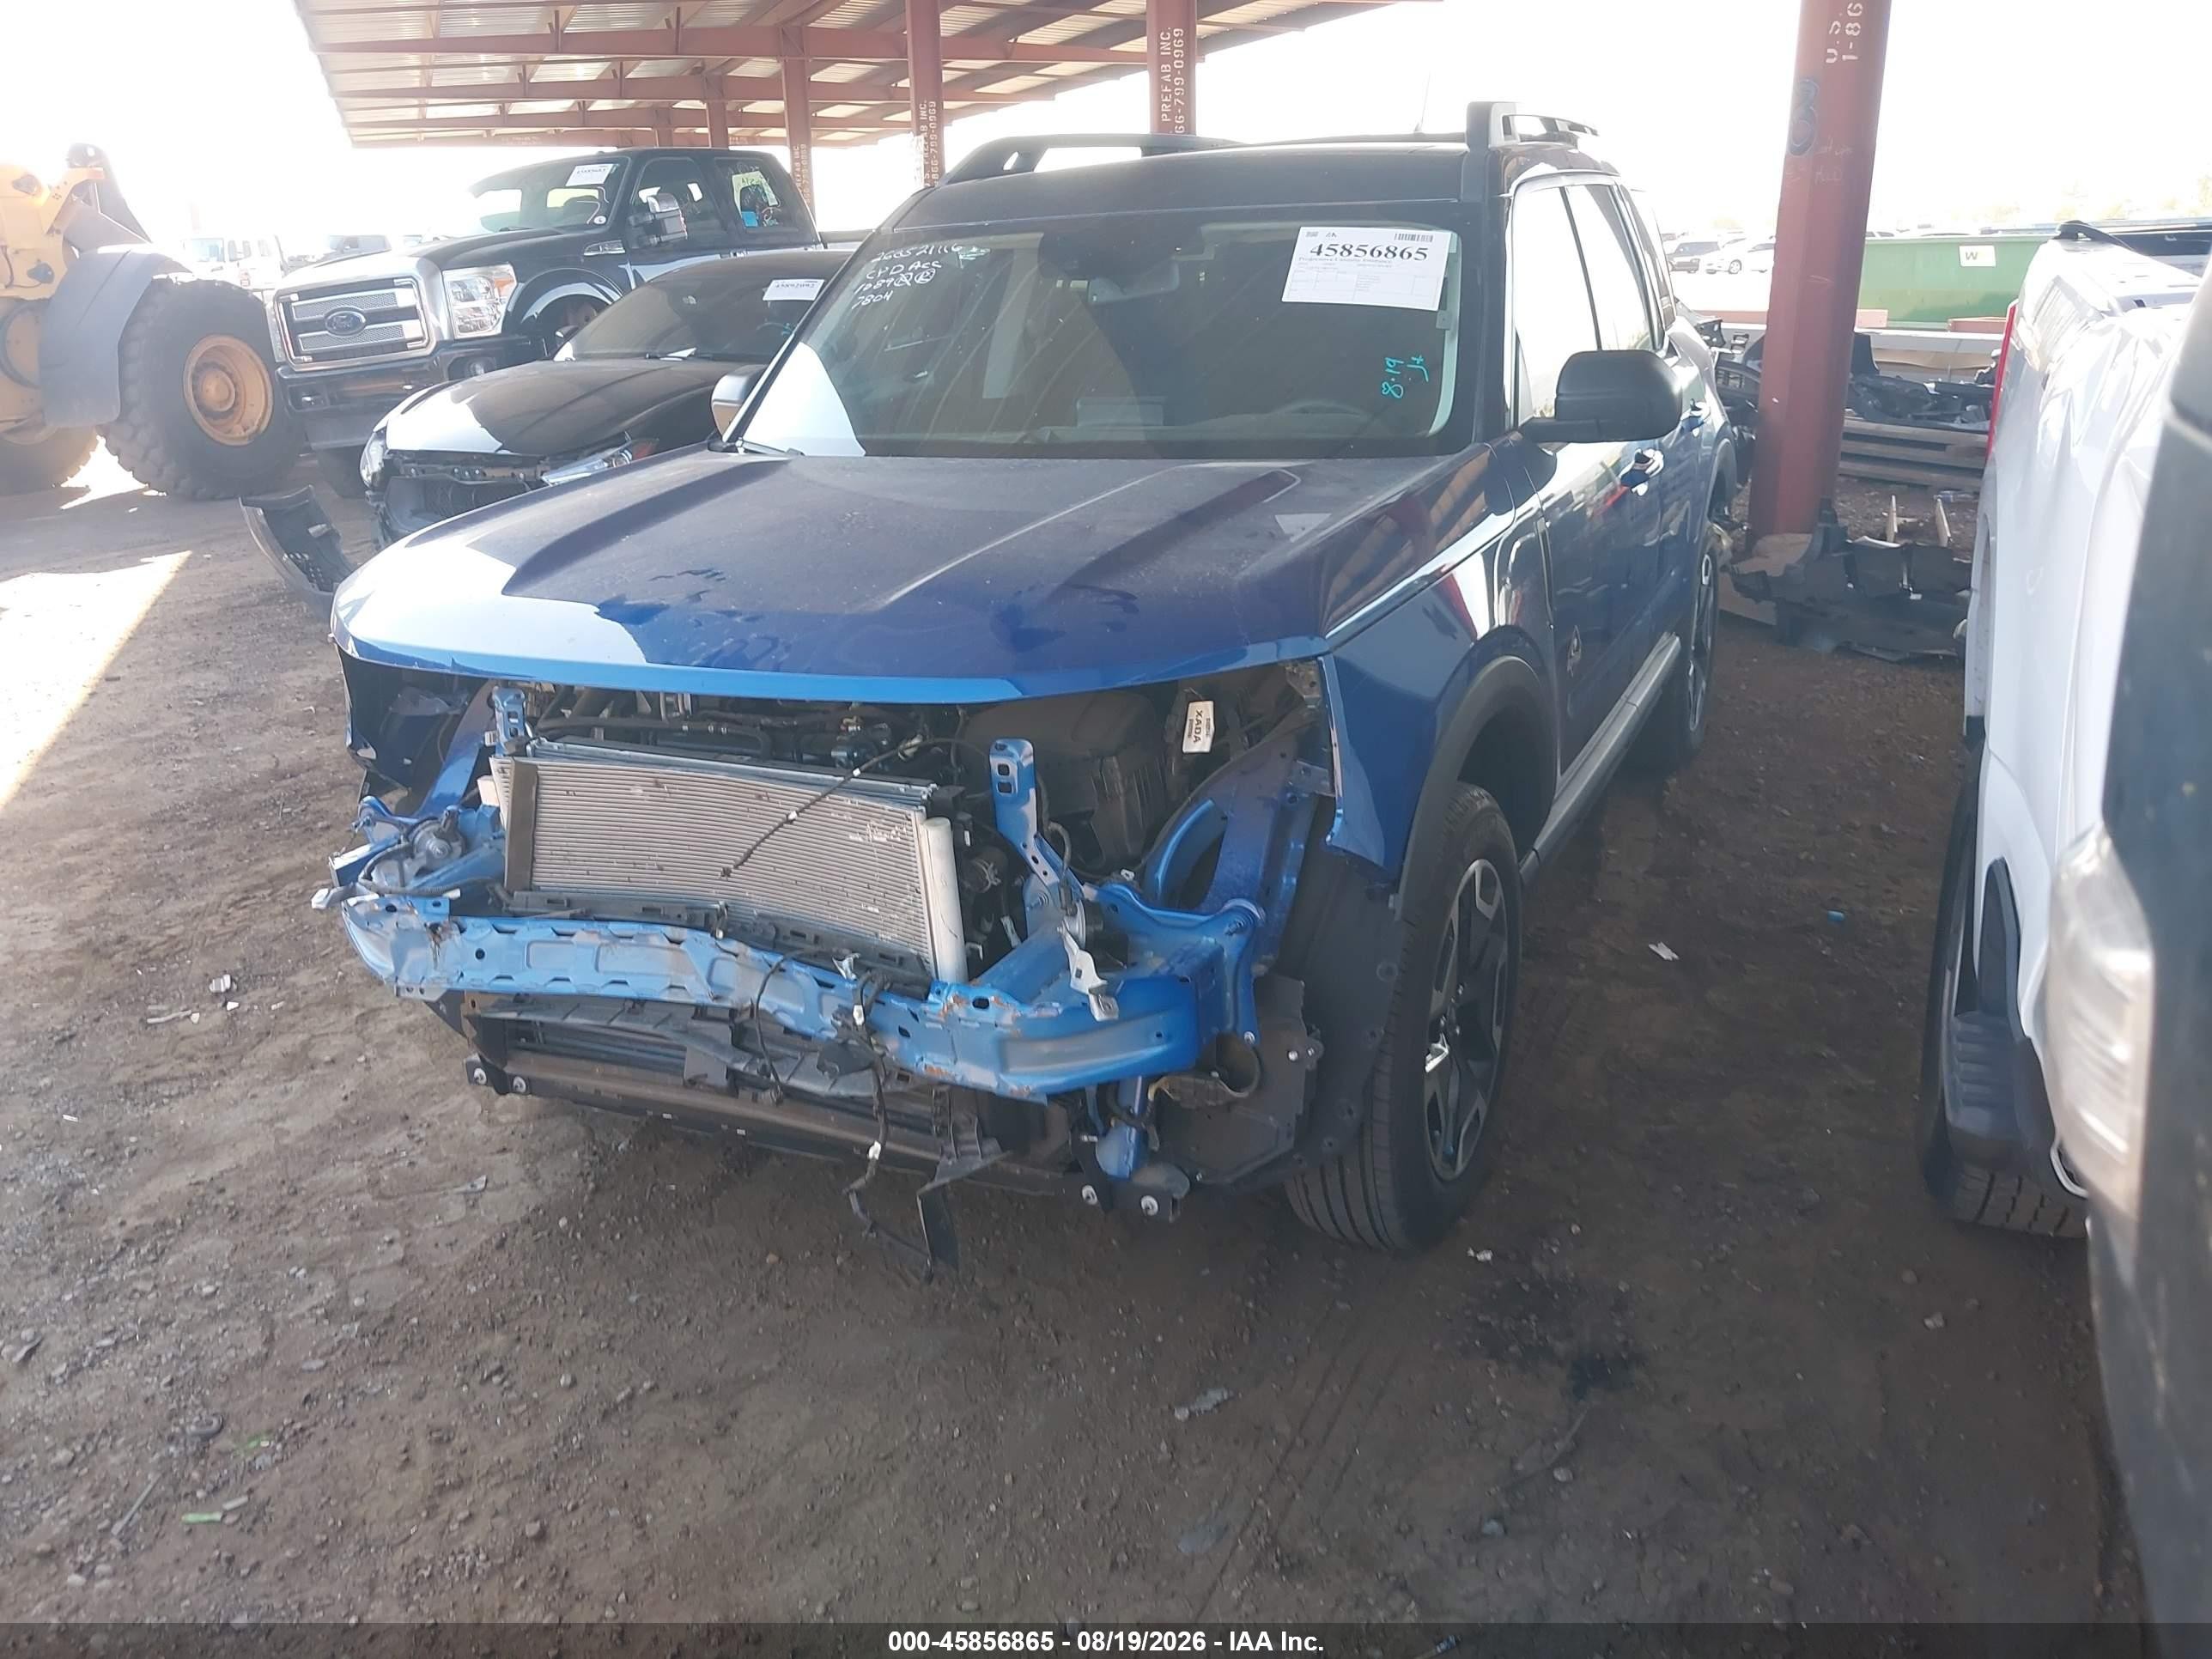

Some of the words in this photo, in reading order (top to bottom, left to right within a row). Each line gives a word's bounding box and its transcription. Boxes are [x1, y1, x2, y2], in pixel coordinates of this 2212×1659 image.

[1159, 27, 1171, 56] INC.
[1160, 64, 1172, 122] PREFAB
[1310, 243, 1429, 261] 45856865
